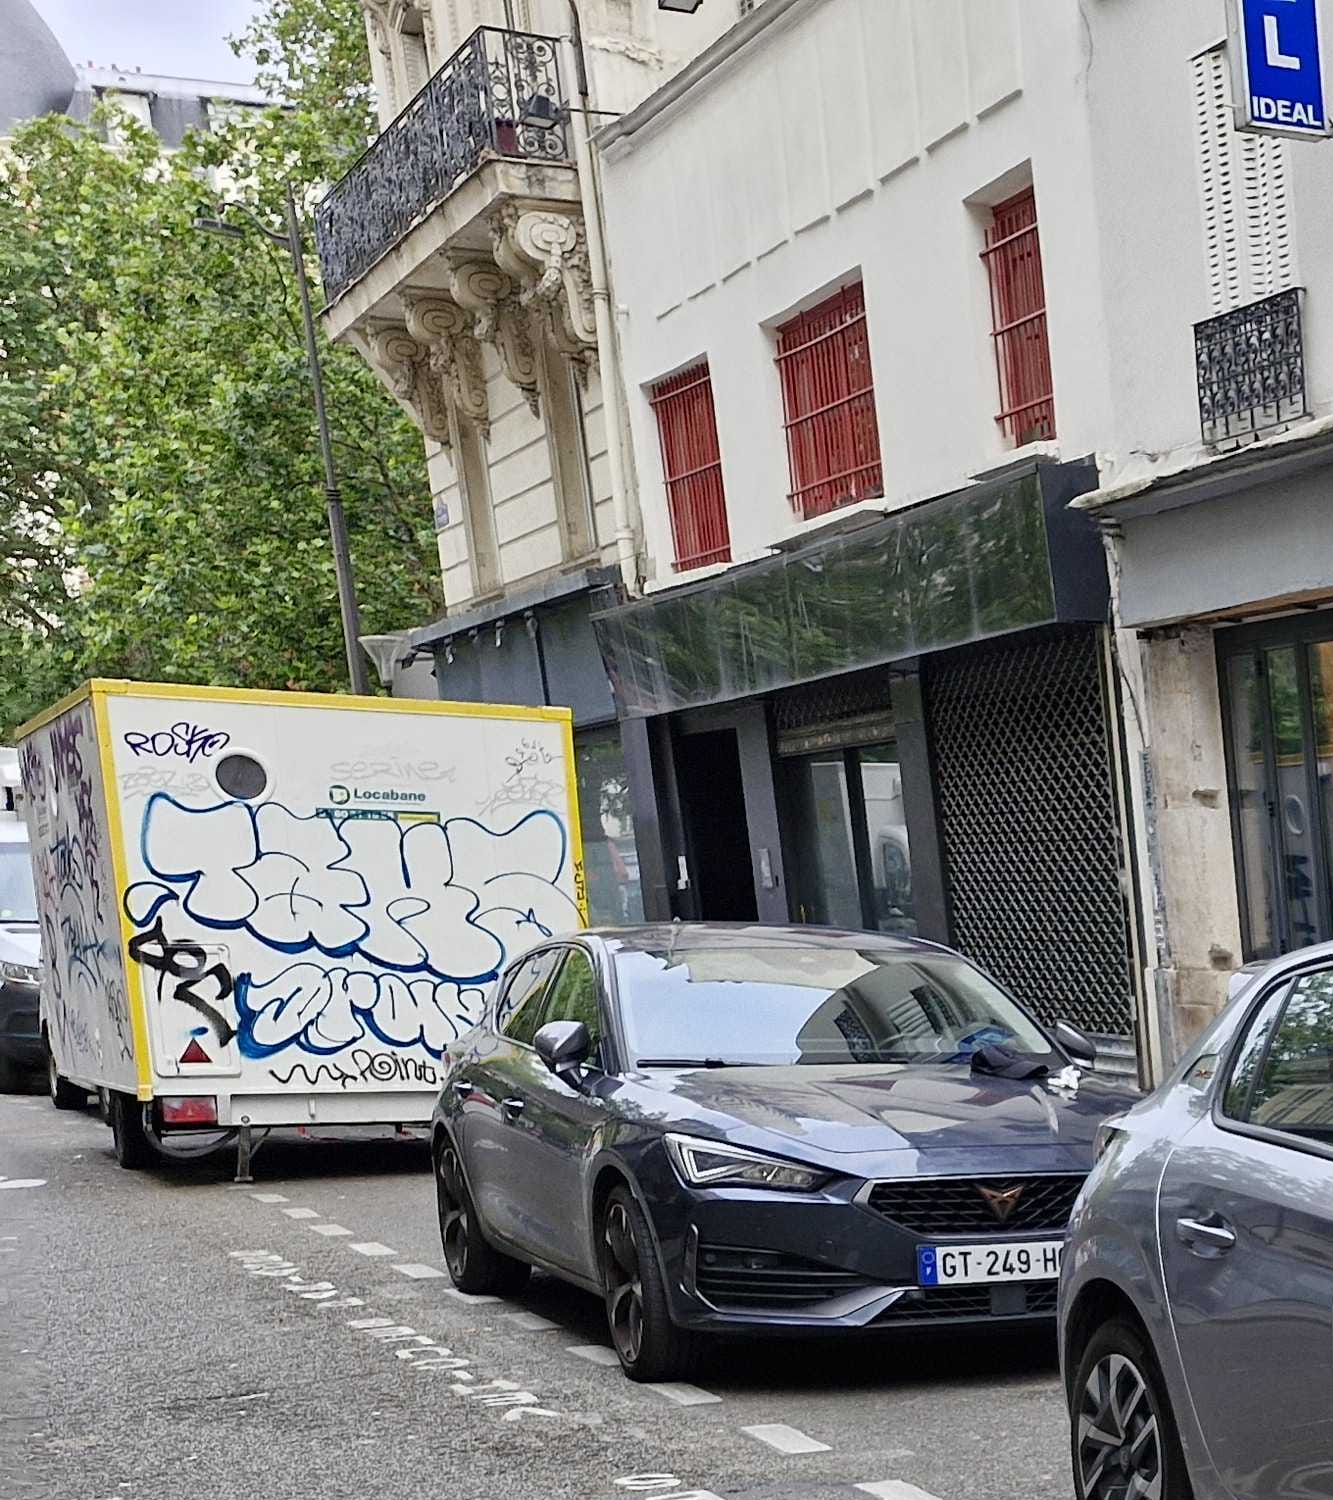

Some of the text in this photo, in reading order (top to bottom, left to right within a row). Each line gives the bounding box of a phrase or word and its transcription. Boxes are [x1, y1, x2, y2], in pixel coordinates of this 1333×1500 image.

[1251, 95, 1323, 127] IDEAL
[354, 787, 426, 802] Locabane
[942, 1247, 1064, 1278] GT-249-H
